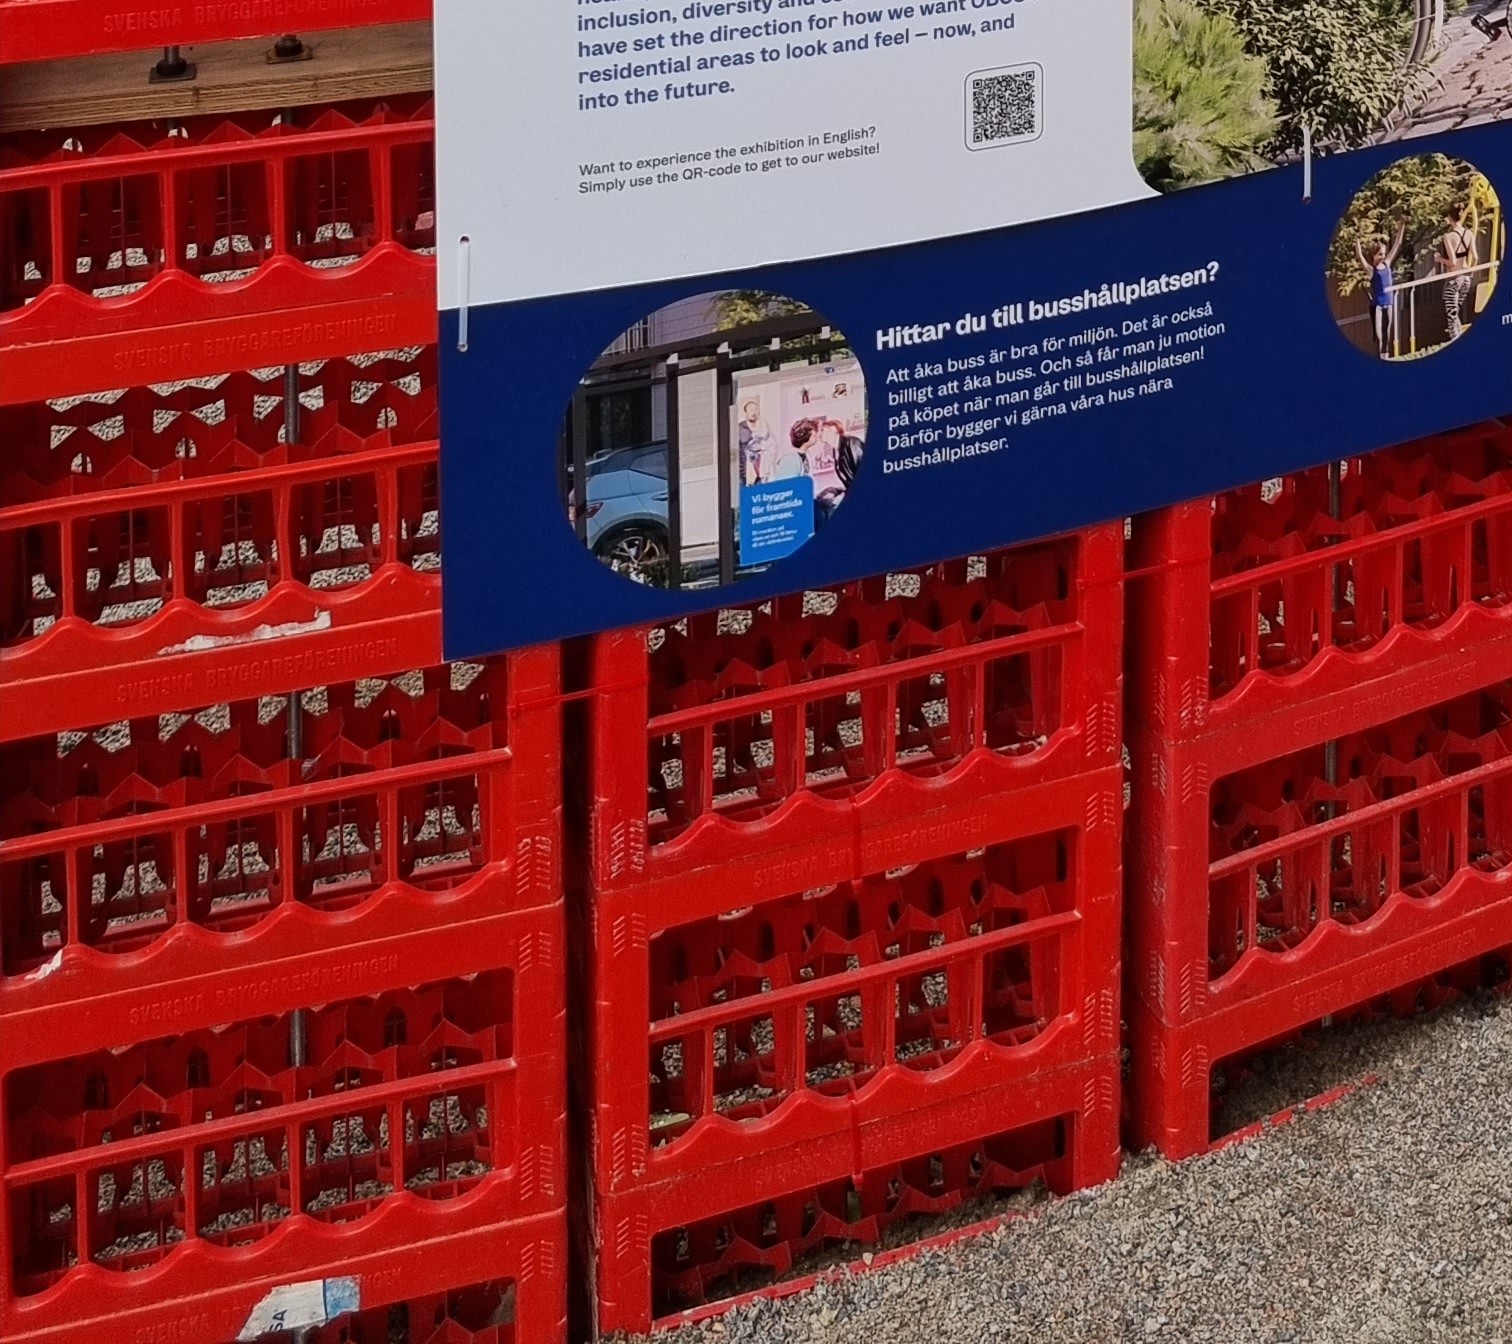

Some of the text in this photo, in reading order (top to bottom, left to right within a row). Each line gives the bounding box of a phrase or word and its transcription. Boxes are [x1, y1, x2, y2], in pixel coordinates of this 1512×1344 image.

[578, 126, 876, 176] Want to experience the exhibition in English?
[578, 142, 880, 194] Simply use the QR-code to get to our website!
[876, 260, 1220, 351] Hittar du till busshållplatsen?
[885, 300, 1214, 385] Att åka buss är bra för miljön. Det är också
